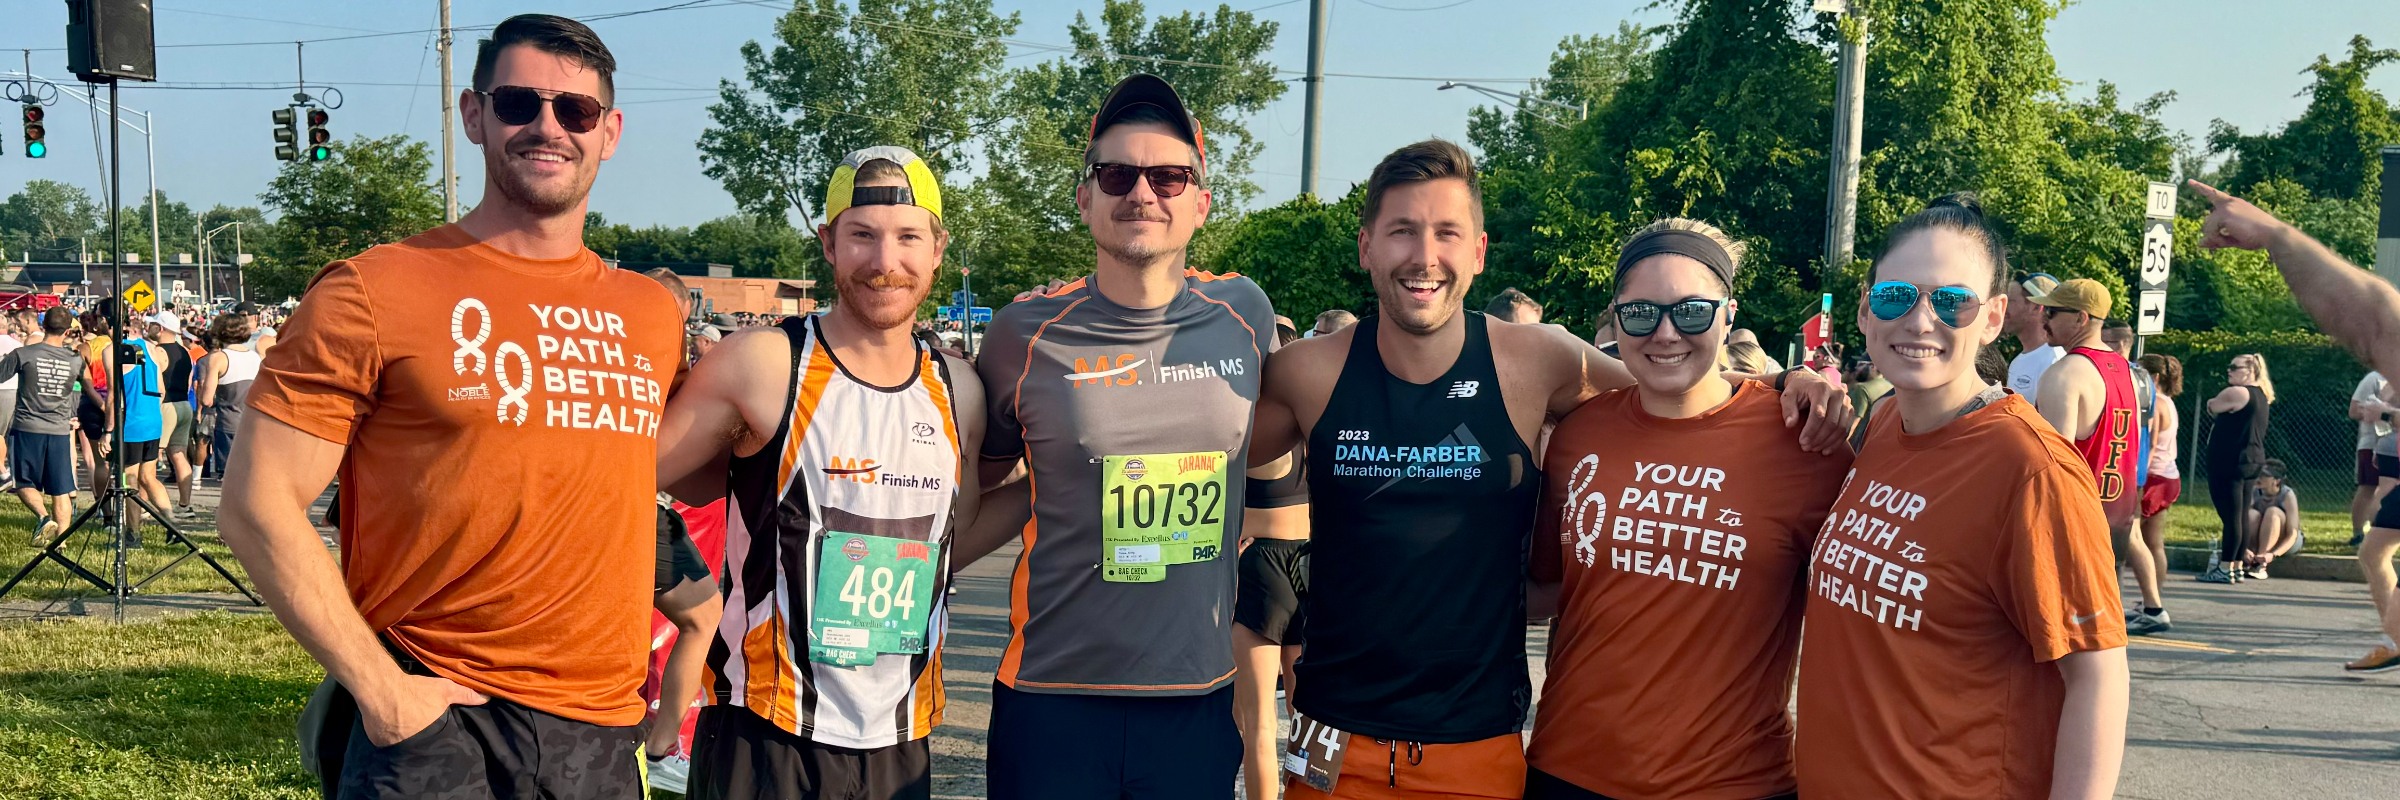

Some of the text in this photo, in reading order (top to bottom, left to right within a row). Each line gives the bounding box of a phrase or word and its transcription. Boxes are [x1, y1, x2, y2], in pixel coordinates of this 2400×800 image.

[2155, 190, 2168, 210] TO
[2146, 237, 2167, 273] 5S
[528, 303, 627, 338] YOUR
[536, 334, 654, 373] PATH to
[1160, 361, 1217, 384] Finish
[1219, 358, 1244, 376] MS
[542, 365, 661, 407] BETTER
[546, 400, 661, 439] HEALTH
[1337, 429, 1370, 441] 2023
[1177, 455, 1217, 476] SARANAC
[1333, 463, 1481, 481] Marathon Challenge
[1335, 444, 1481, 463] DANA-FARBER
[881, 473, 918, 488] Finish
[921, 476, 941, 490] MS
[1635, 461, 1726, 492] YOUR
[1110, 480, 1221, 529] 10732
[1618, 487, 1744, 527] PATH to
[1859, 480, 1926, 522] YOUR
[1193, 544, 1216, 560] PAR
[1612, 515, 1747, 561] BETTER
[1838, 508, 1927, 563] PATH to
[1130, 567, 1148, 575] CHECK
[1611, 547, 1741, 591] HEALTH
[1822, 538, 1929, 602] BETTER
[839, 564, 916, 620] 484
[1818, 570, 1923, 632] HEALTH
